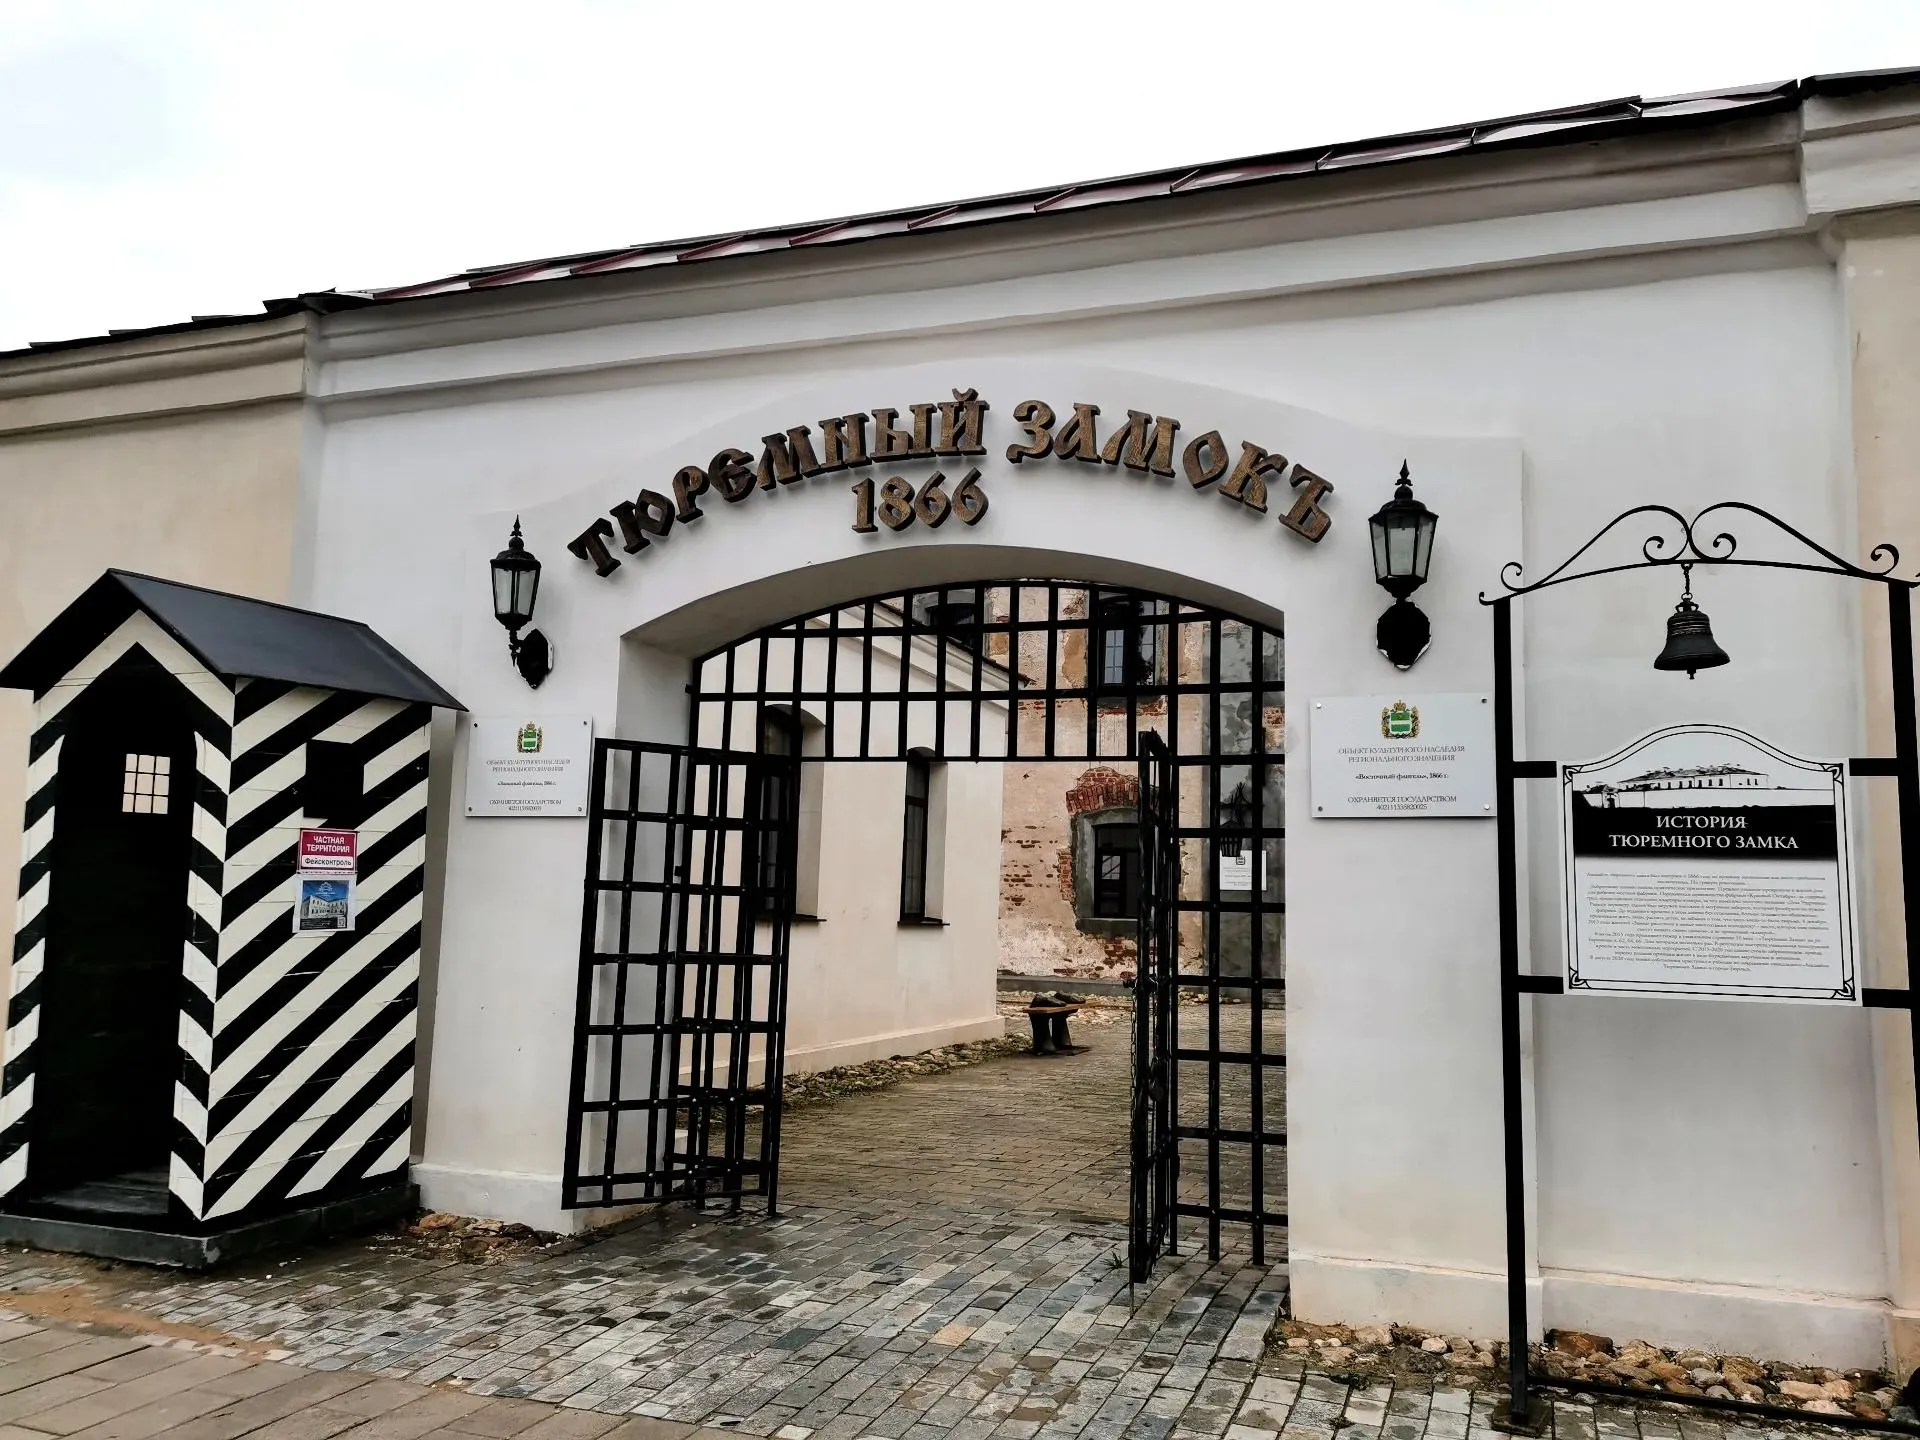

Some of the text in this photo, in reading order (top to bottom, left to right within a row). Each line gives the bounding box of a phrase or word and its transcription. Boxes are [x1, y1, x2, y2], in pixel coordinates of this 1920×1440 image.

[567, 388, 1334, 577] ТЮРЕМНЫЙ ЗАМОКЪ
[852, 467, 989, 533] 1866
[1656, 815, 1747, 829] ИСТОРИЯ
[313, 835, 345, 845] ЧАСТНАЯ
[1608, 834, 1799, 849] ТЮРЕМНОГО ЗАМКА
[306, 843, 351, 853] ТЕРРИТОРИЯ
[304, 857, 352, 867] Фейсконтроль
